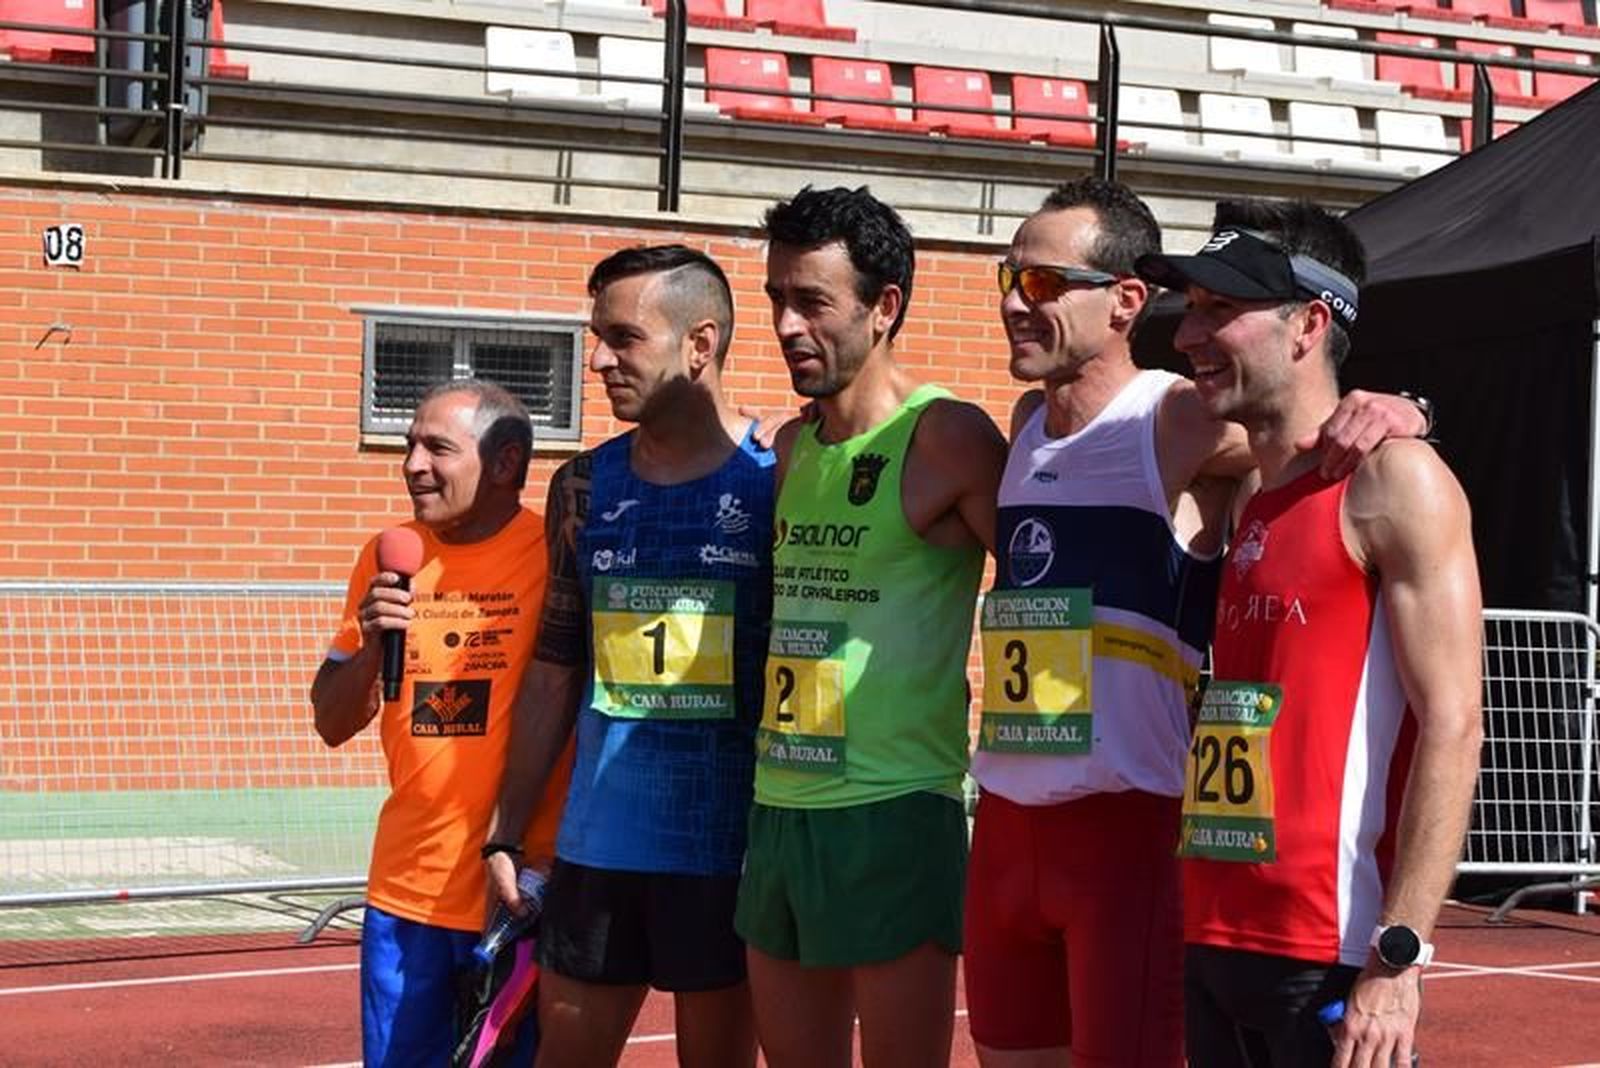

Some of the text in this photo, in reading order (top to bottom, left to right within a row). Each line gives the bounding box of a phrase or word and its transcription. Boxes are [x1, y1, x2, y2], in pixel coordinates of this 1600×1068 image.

[642, 620, 667, 676] 1
[1003, 639, 1029, 703] 3
[632, 693, 727, 708] CAJA RURAL
[775, 666, 796, 723] 2
[1026, 726, 1083, 743] RURAL
[1191, 735, 1255, 805] 126
